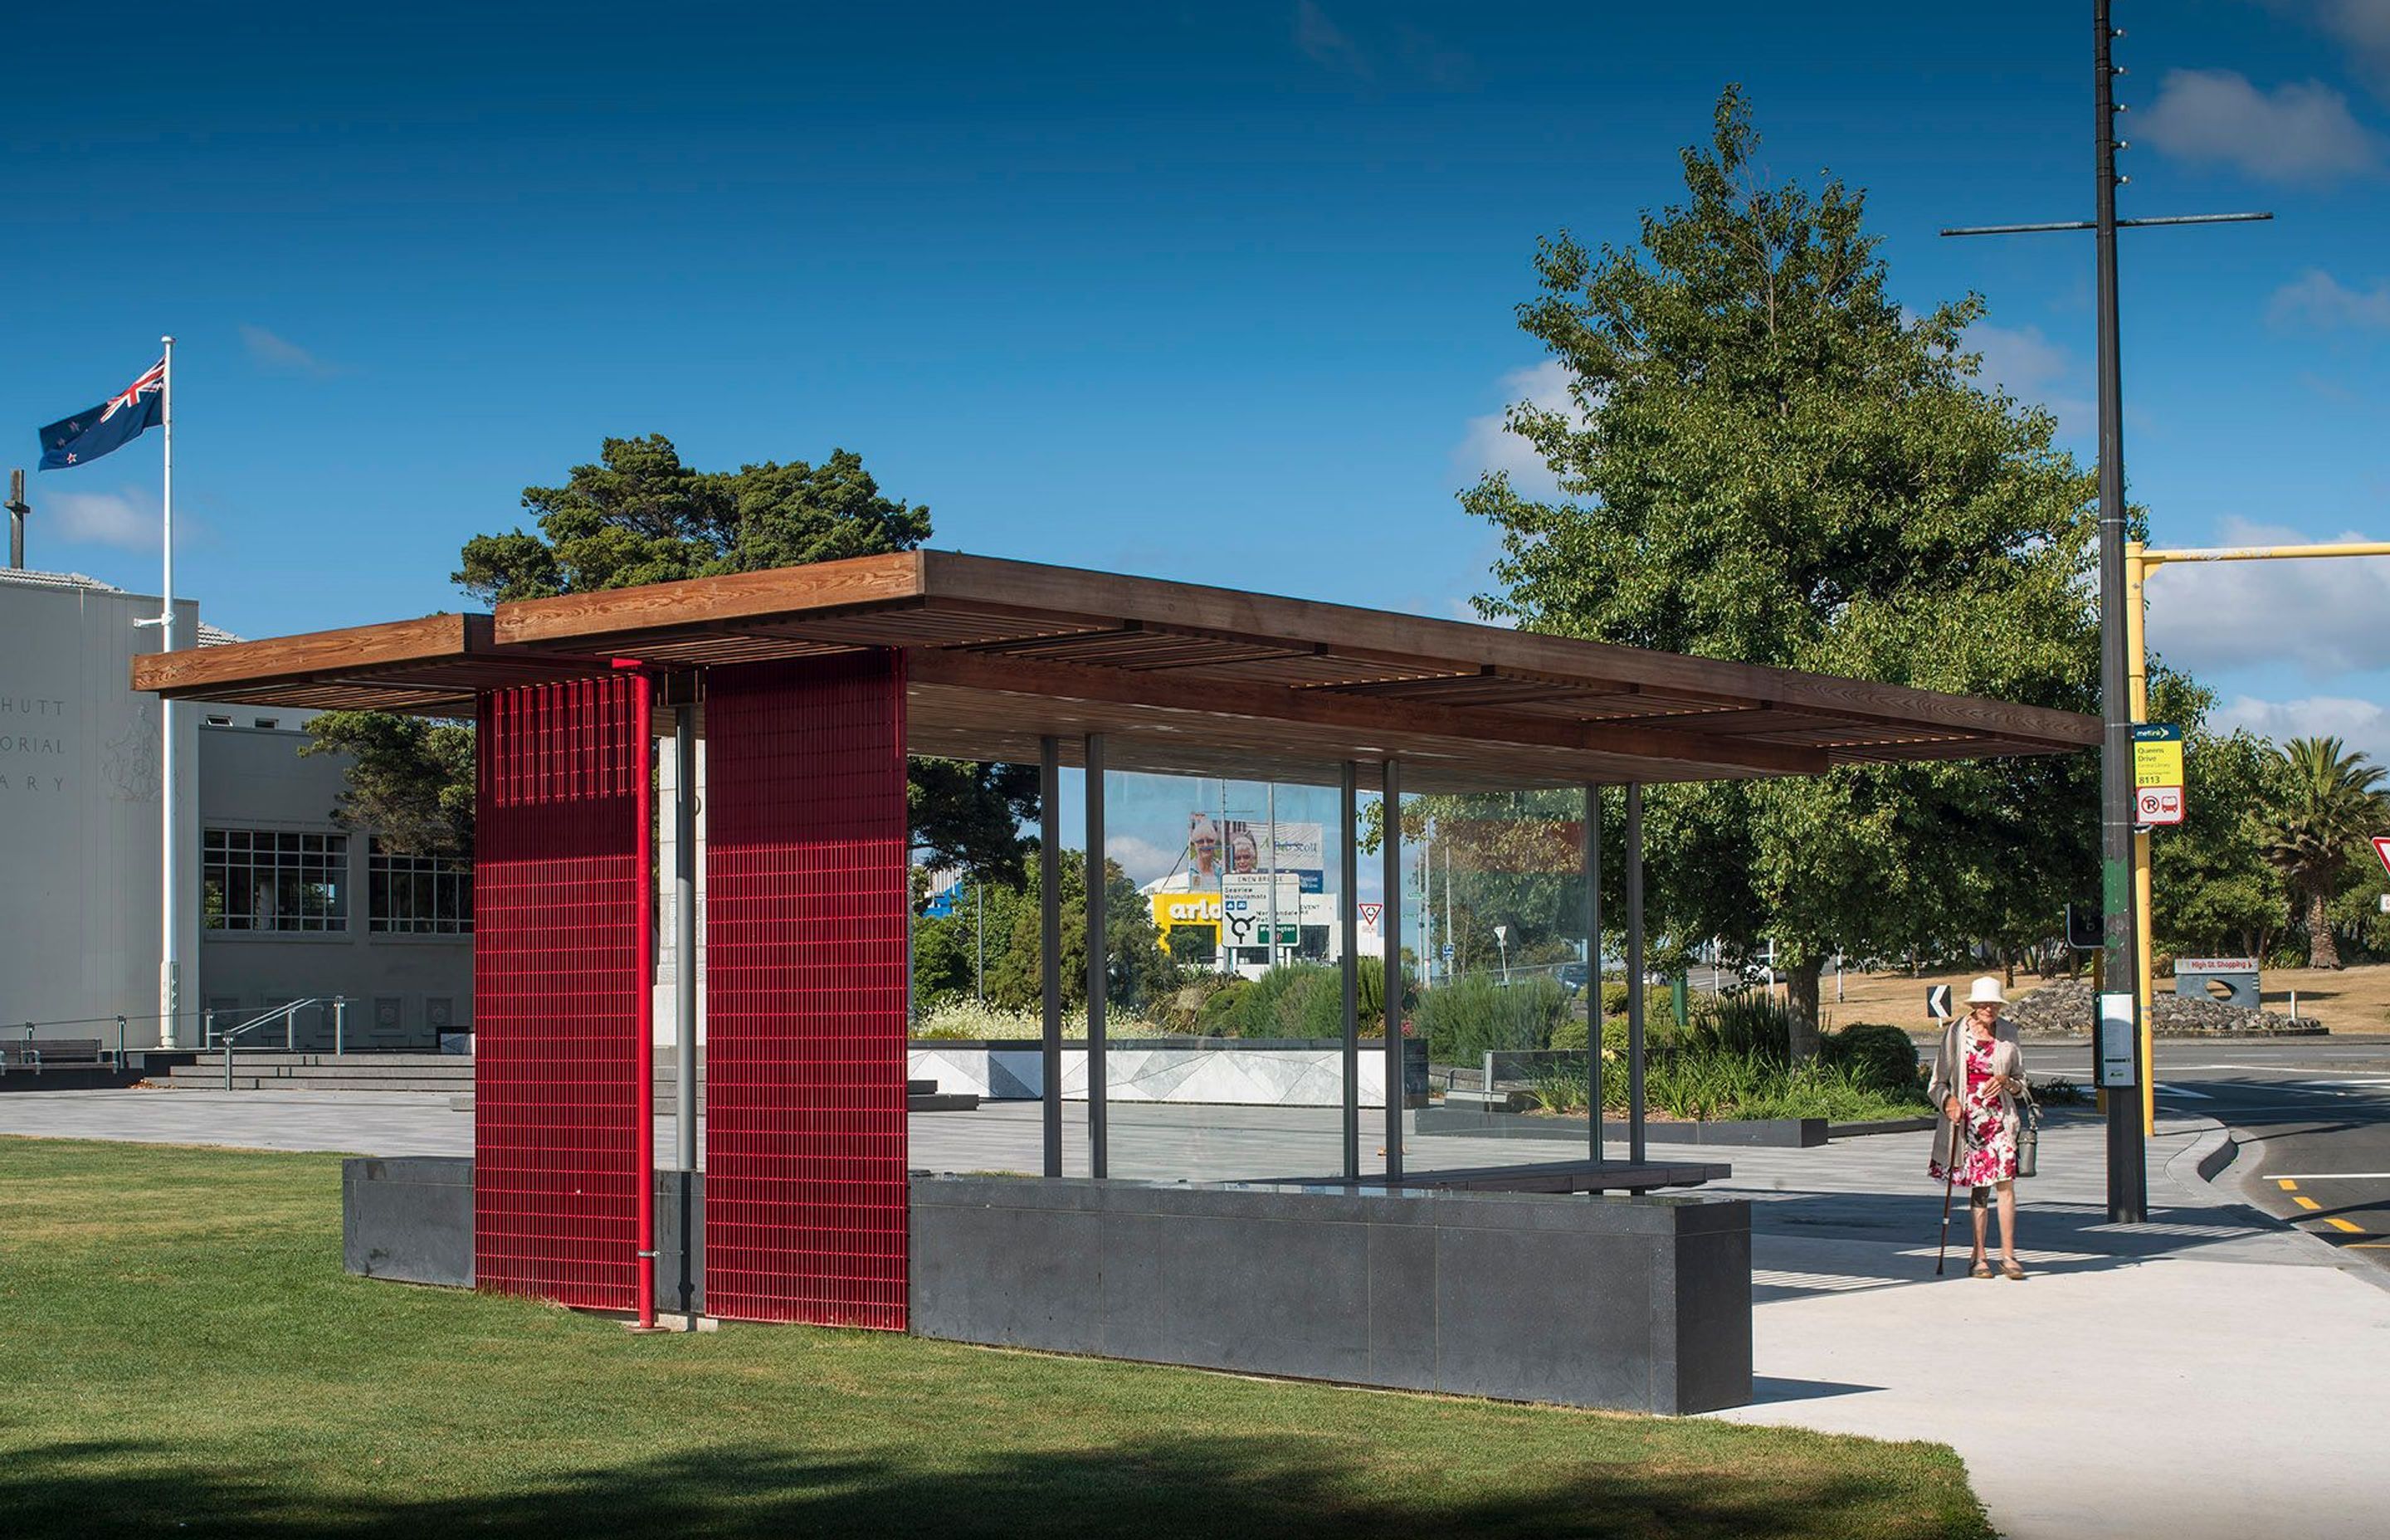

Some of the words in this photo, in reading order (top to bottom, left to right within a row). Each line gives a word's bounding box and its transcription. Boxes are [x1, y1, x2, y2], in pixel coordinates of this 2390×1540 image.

[2, 698, 66, 715] HUTT
[2139, 776, 2160, 784] 8113
[2192, 961, 2207, 969] High
[2217, 961, 2246, 969] Shopping
